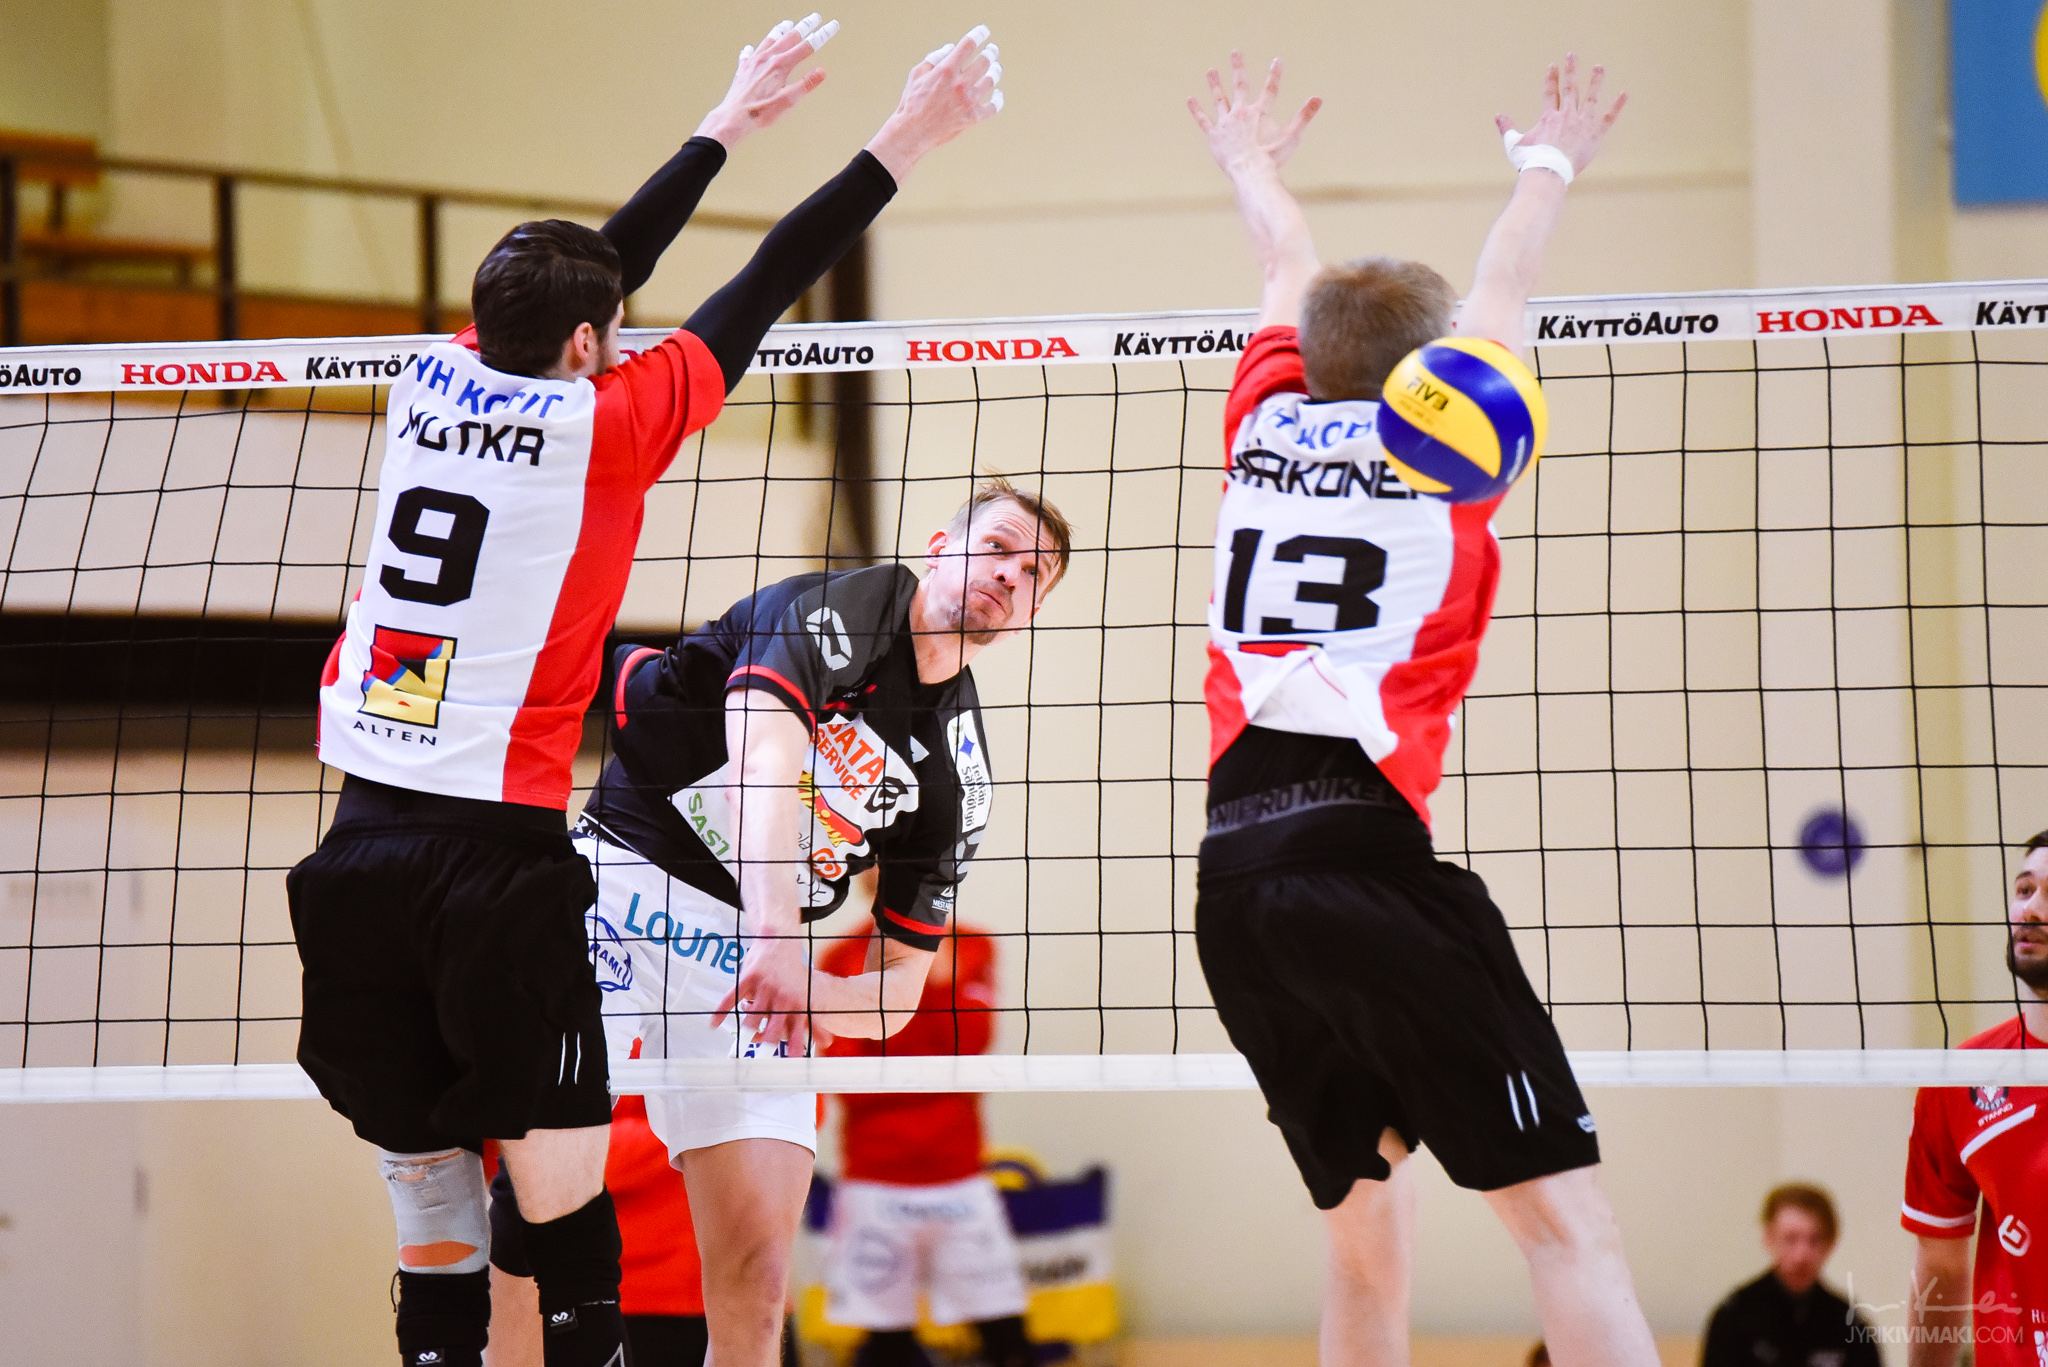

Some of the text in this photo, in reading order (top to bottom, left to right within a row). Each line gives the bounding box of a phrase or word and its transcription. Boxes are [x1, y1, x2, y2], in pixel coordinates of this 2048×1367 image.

[1757, 304, 1943, 334] HONDA
[906, 337, 1080, 362] HONDA
[121, 361, 288, 385] HONDA
[379, 486, 490, 607] 9
[1223, 527, 1388, 635] 13
[353, 720, 437, 746] ALTEN
[811, 728, 867, 801] SERVICE
